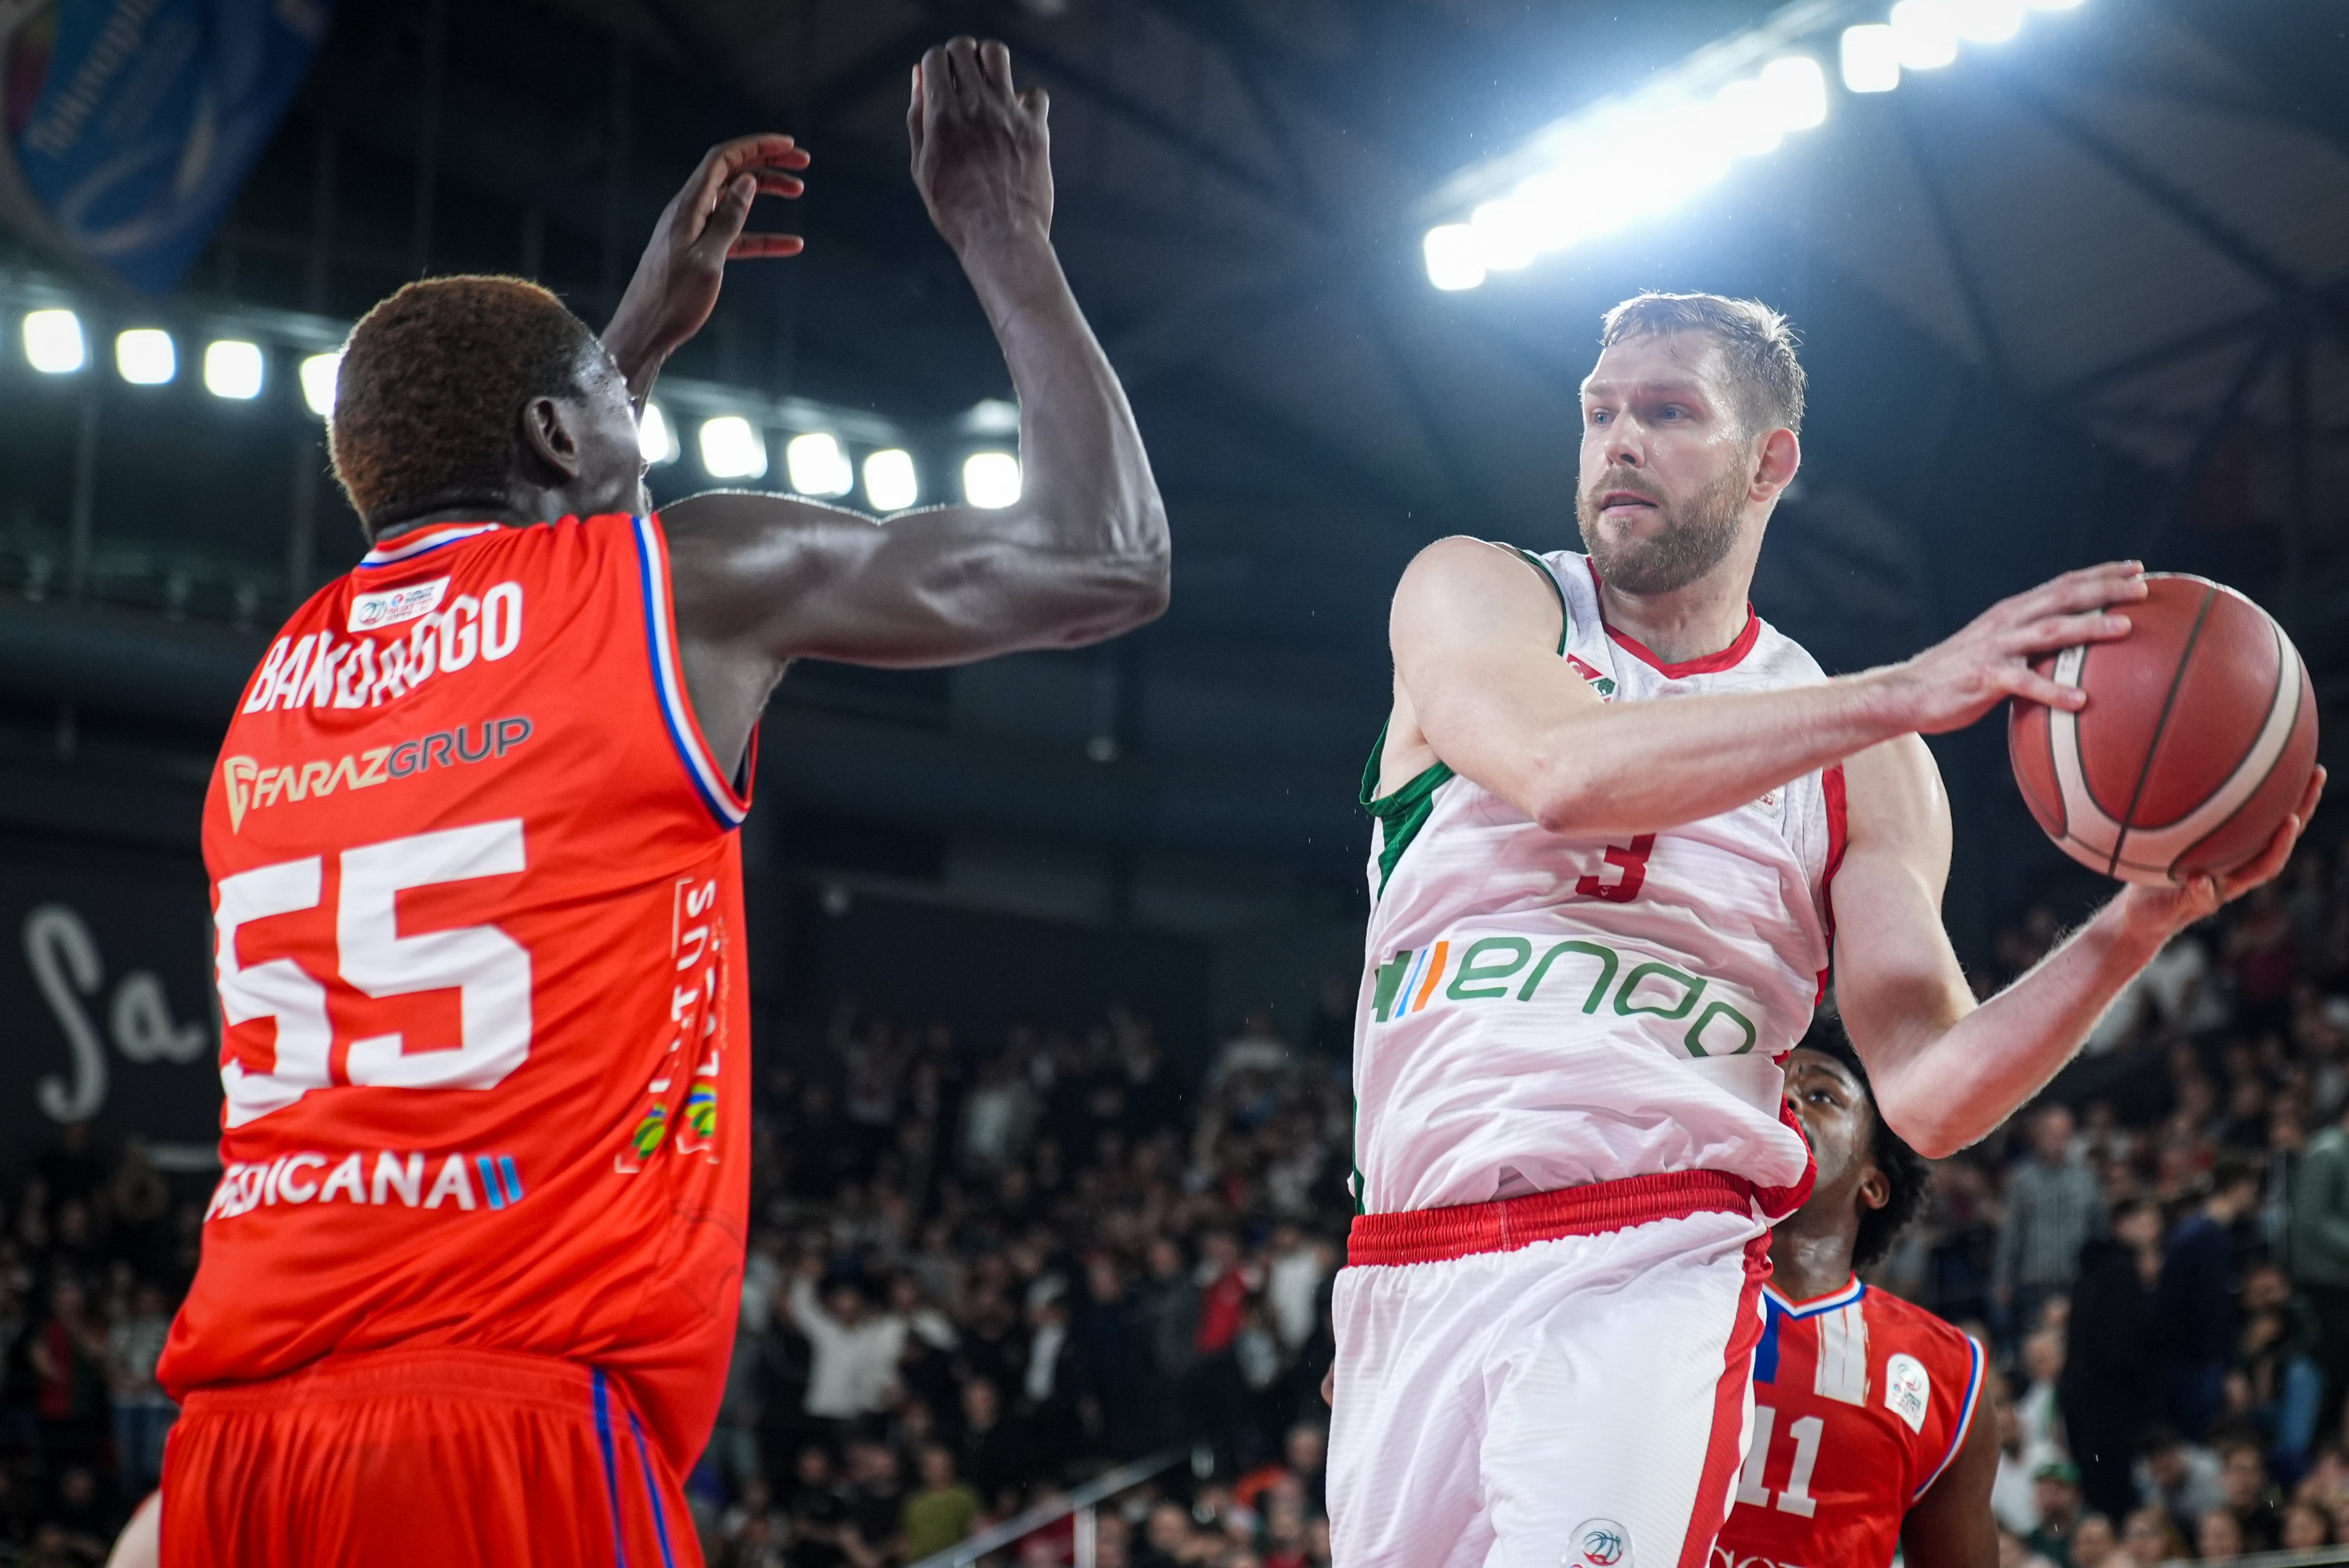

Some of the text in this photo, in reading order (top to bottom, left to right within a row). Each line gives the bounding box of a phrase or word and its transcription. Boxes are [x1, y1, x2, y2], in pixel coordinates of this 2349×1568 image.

[252, 716, 533, 810] FARAZGRUP
[215, 818, 533, 1128] 55
[1735, 1405, 1824, 1518] 11
